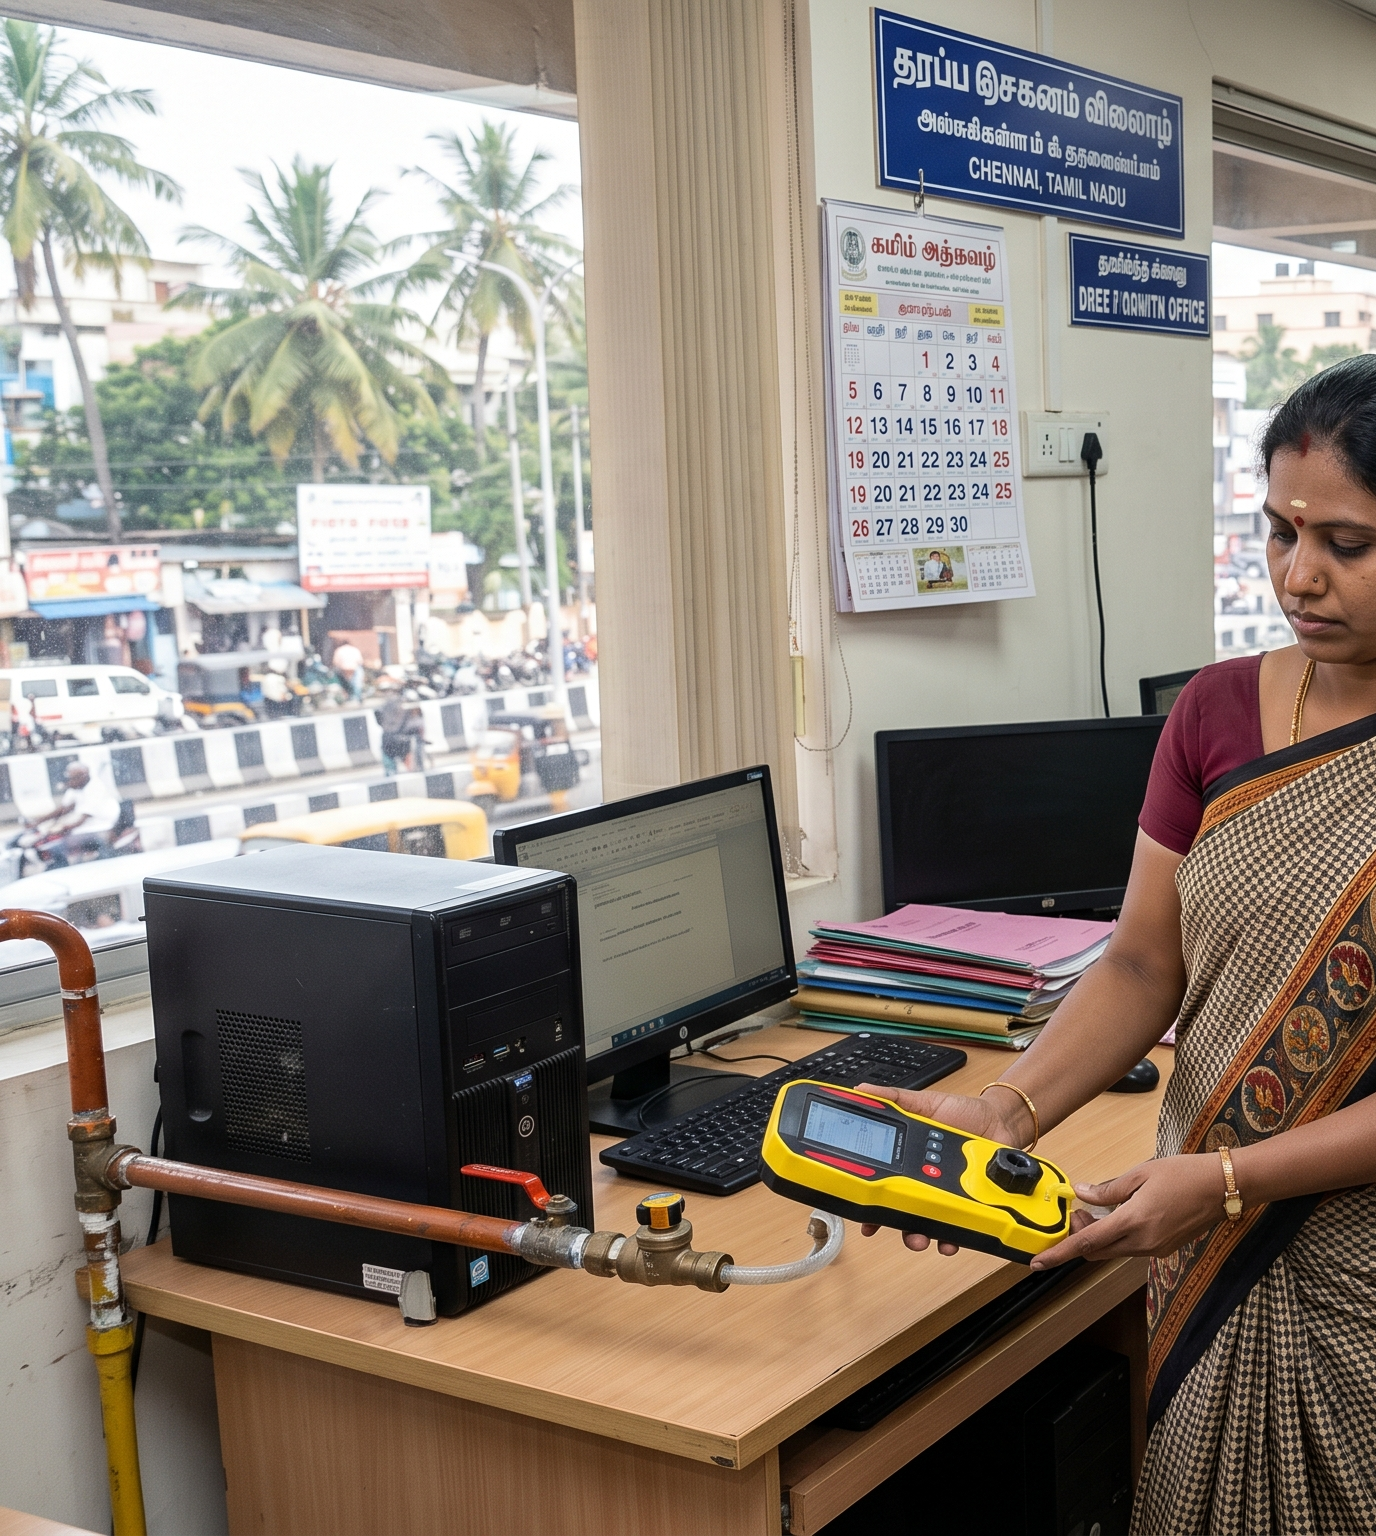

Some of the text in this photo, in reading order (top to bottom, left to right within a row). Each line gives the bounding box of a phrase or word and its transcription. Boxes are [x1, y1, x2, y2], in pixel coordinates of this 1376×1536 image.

[968, 156, 1126, 208] CHENNAI, TAMIL NADU
[1079, 285, 1110, 314] DREE
[1168, 296, 1205, 325] OFFICE
[921, 350, 1000, 372] 1 2 3 4
[849, 381, 1005, 405] 5 6 7 8 9 10 11
[846, 416, 1008, 436] 12 13 14 15 16 17 18
[848, 450, 1010, 469] 19 20 21 22 23 24 25
[850, 482, 1012, 504] 19 20 21 22 23 24 25
[852, 515, 968, 538] 26 27 28 29 30
